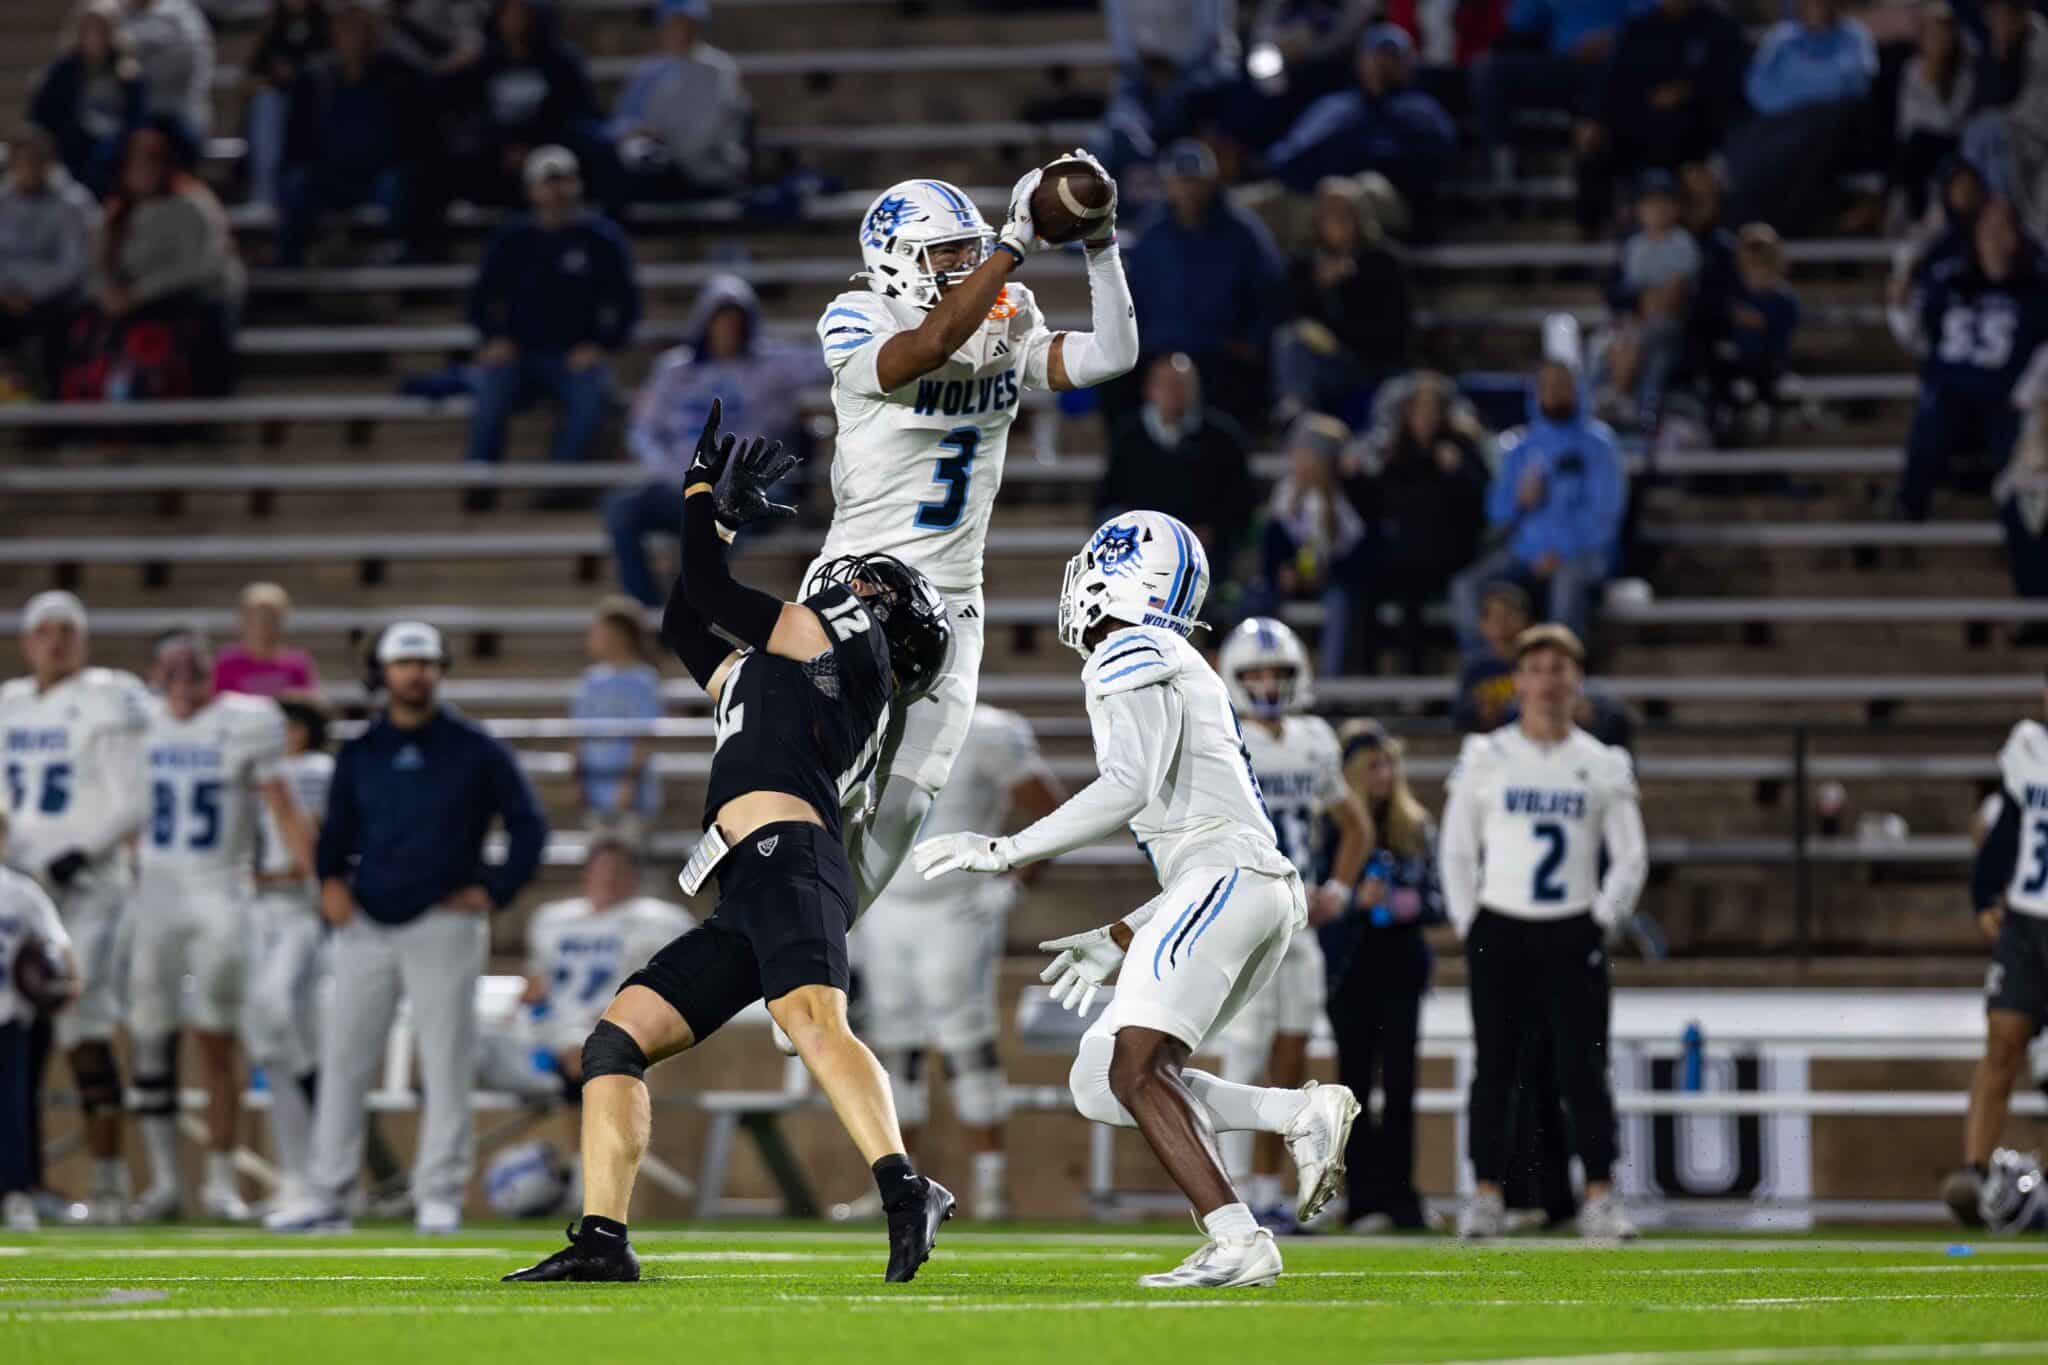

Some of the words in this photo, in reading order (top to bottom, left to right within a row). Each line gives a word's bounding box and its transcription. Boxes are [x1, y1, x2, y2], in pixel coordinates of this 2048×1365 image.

[913, 369, 1020, 417] WOLVES
[913, 425, 981, 531] 3
[821, 594, 871, 642] 12
[1142, 613, 1191, 647] WOLFPAC
[1504, 786, 1585, 818] WOLVES
[1531, 822, 1567, 903] 2
[1648, 1052, 1761, 1200] U
